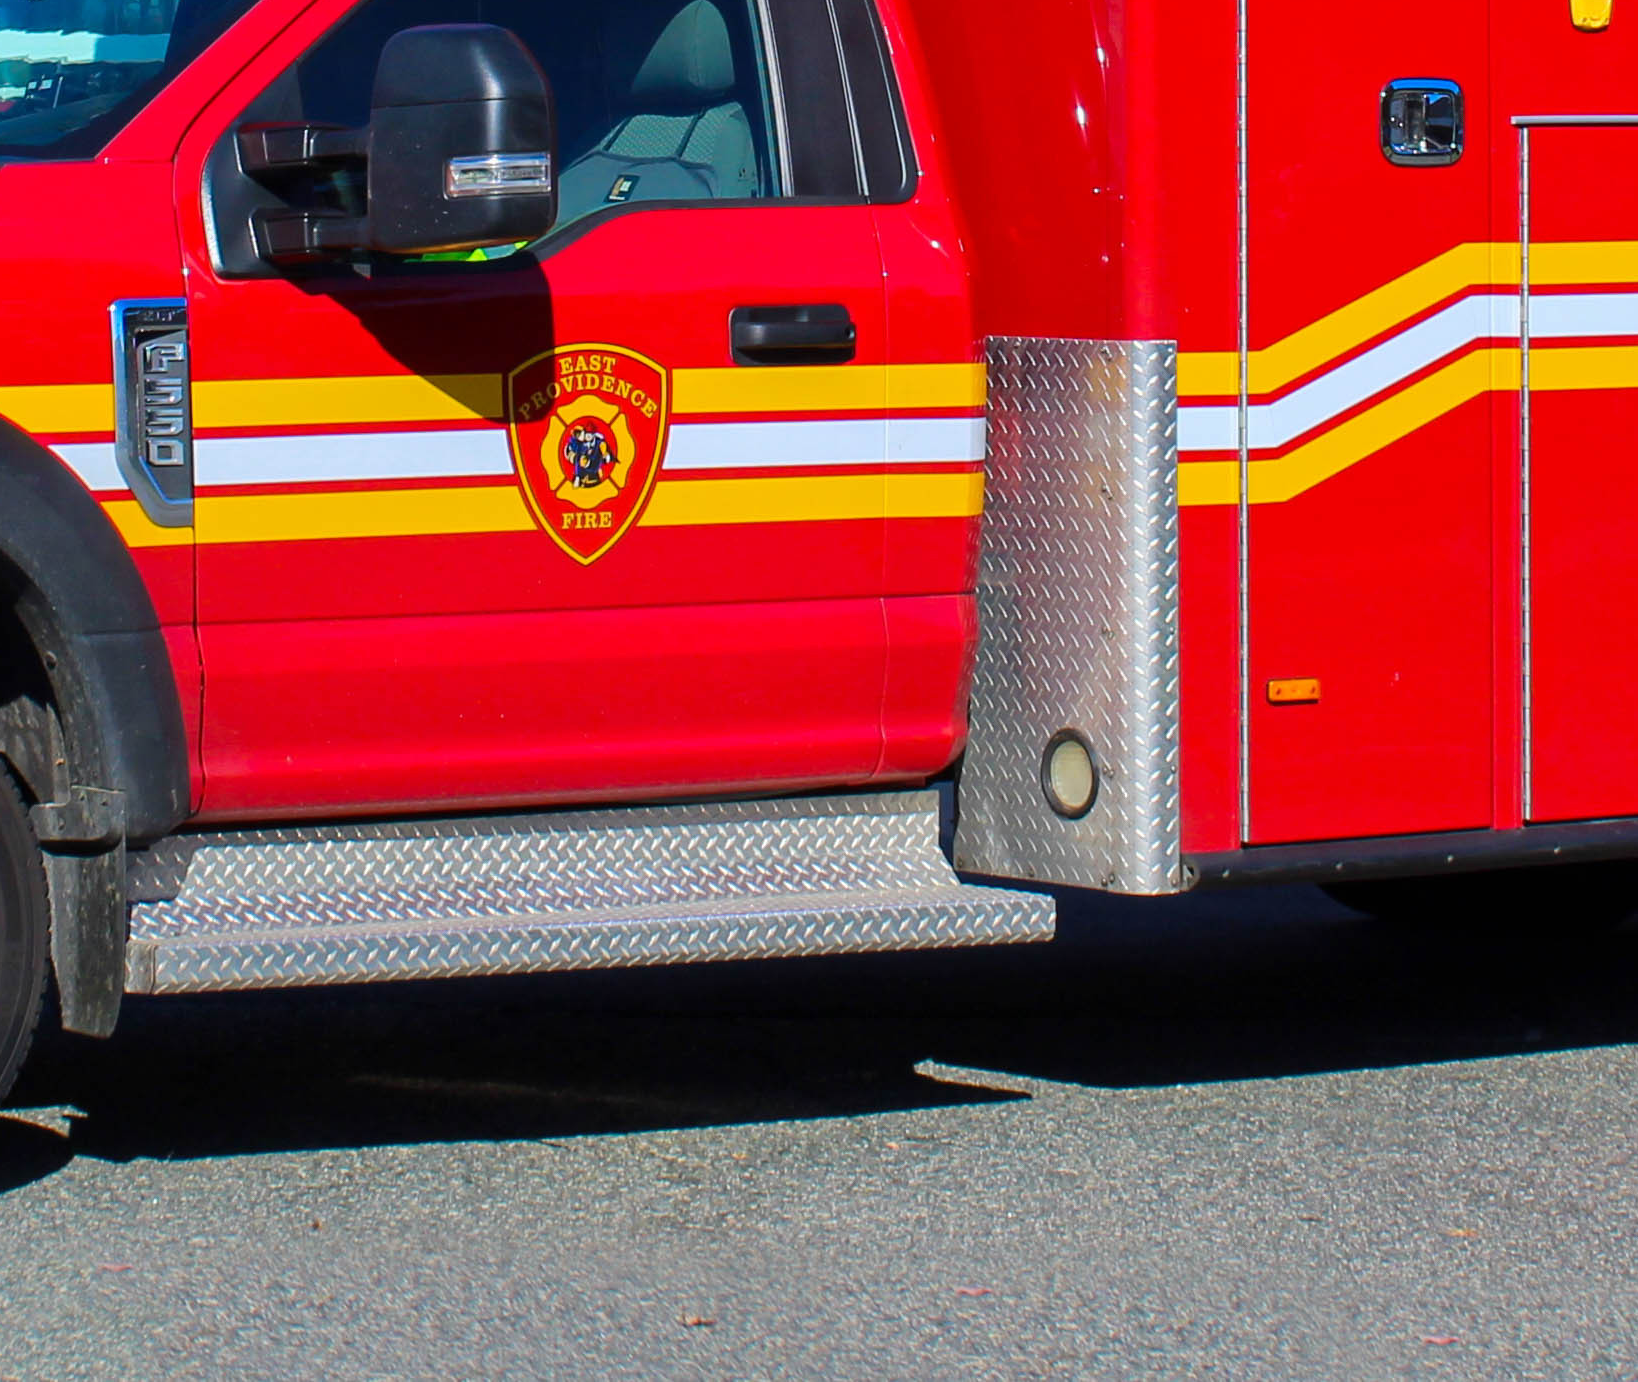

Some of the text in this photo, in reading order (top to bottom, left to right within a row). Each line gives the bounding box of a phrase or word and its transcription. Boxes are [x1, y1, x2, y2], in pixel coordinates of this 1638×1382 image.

[559, 355, 616, 375] EAST
[519, 373, 659, 421] PROVIDENCE
[562, 512, 612, 529] FIRE
